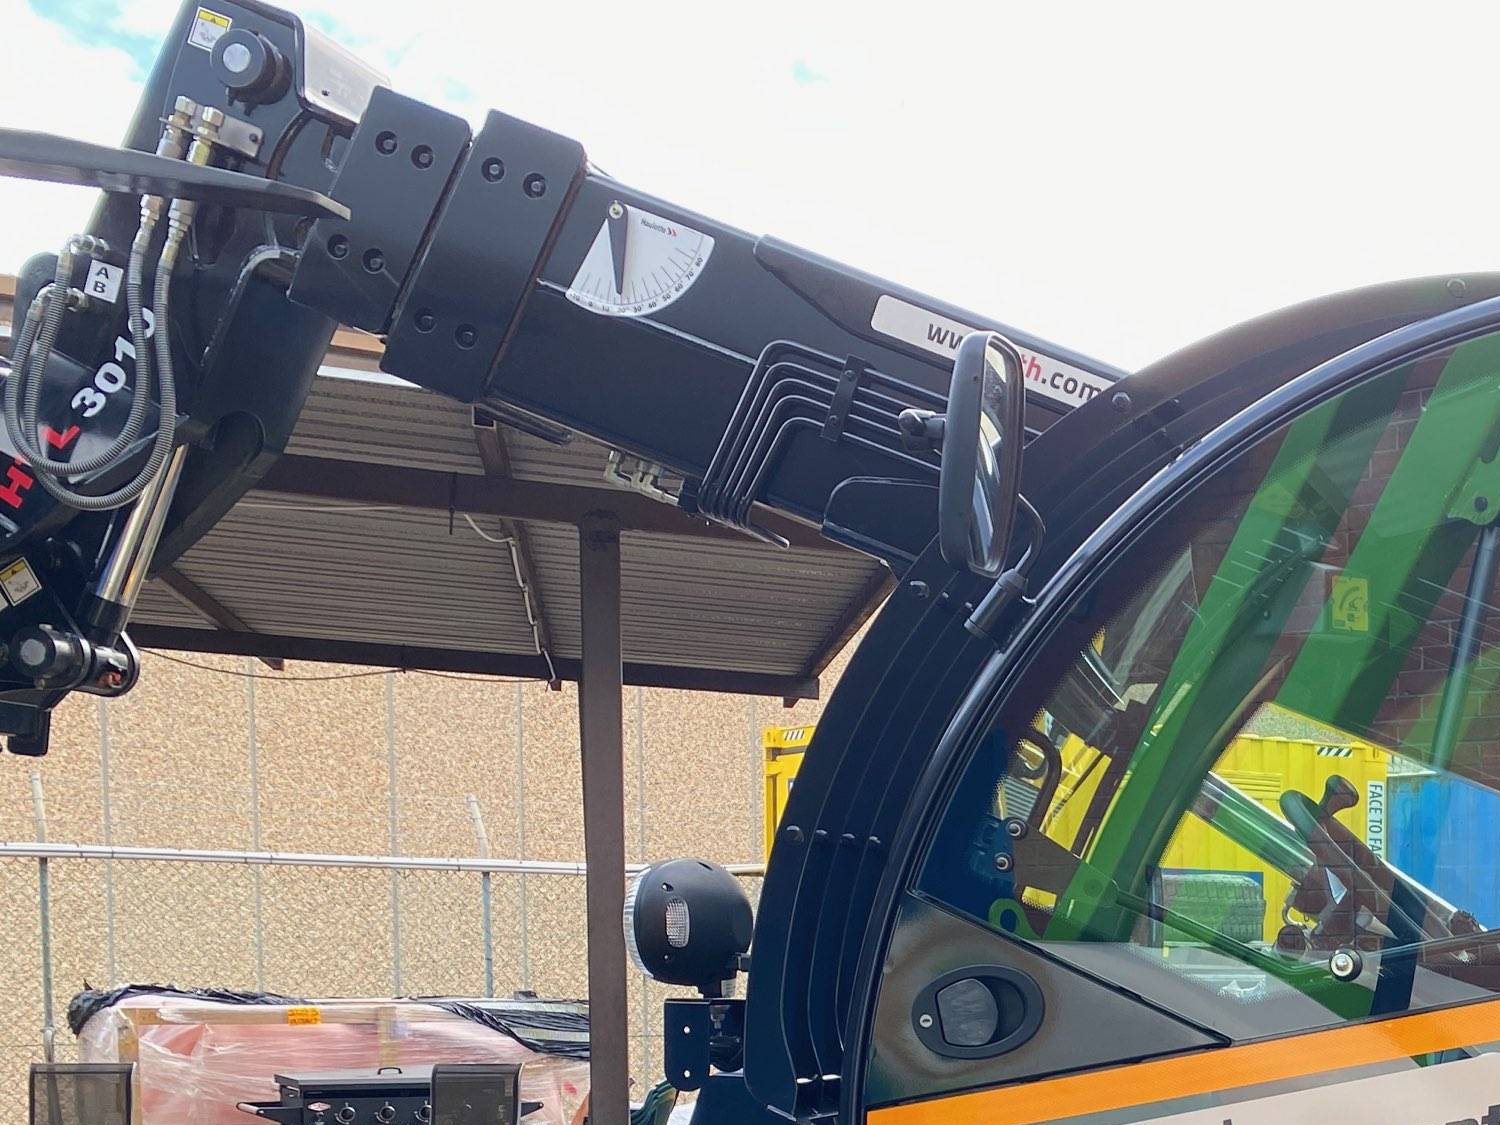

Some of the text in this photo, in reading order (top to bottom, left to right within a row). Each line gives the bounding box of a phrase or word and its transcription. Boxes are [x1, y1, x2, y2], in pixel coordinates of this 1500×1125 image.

[96, 266, 109, 280] A
[93, 281, 106, 294] B
[1368, 784, 1383, 814] FACE
[1368, 819, 1383, 834] TO
